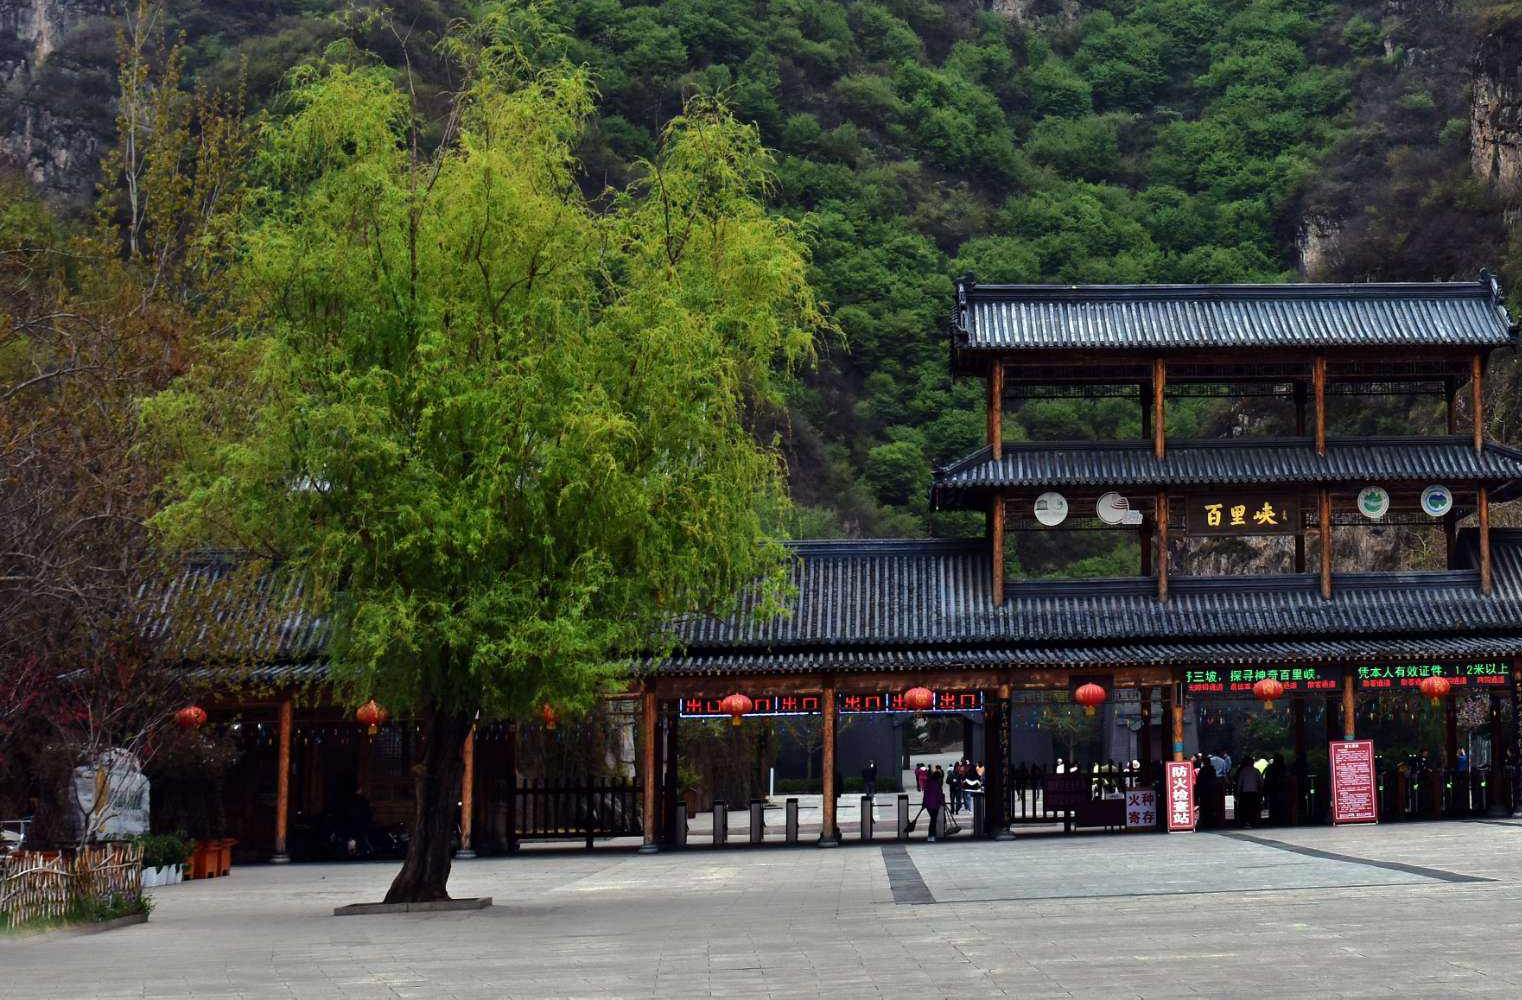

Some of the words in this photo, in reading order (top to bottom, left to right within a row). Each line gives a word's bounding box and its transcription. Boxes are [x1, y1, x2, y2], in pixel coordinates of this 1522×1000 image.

[1204, 502, 1279, 526] 百里峡
[940, 692, 976, 708] 出口
[1172, 766, 1189, 824] 防火检查站
